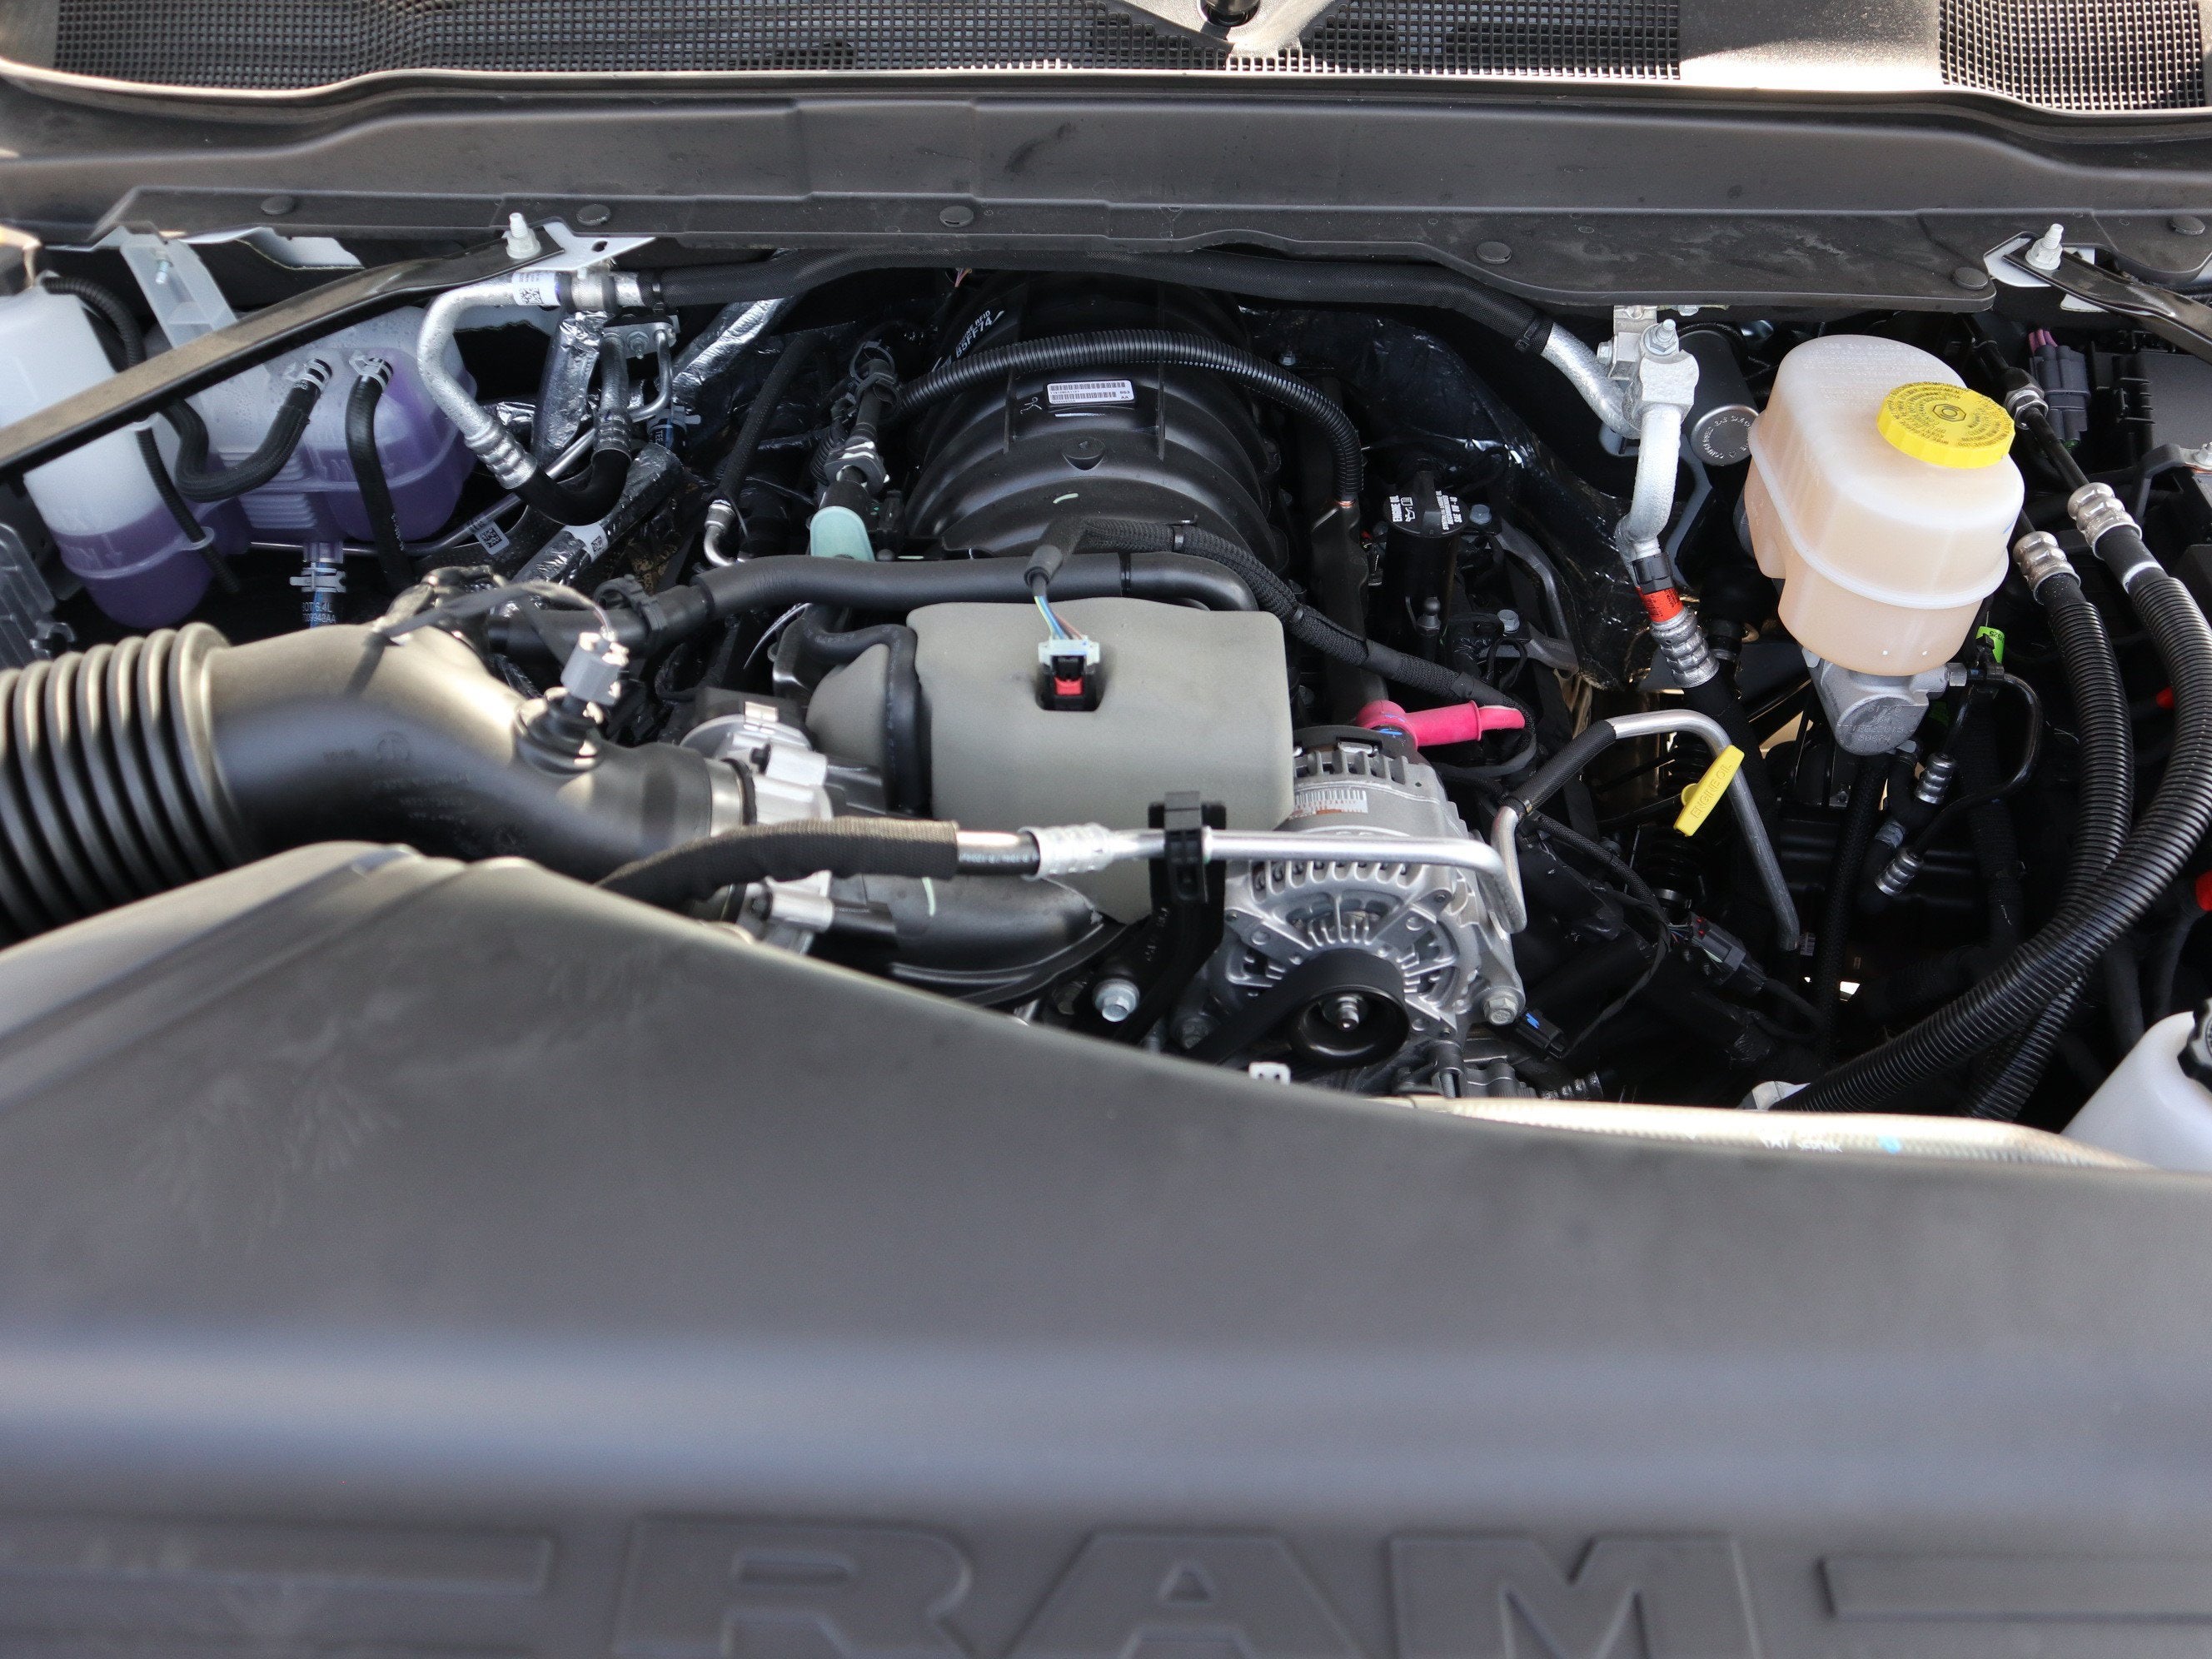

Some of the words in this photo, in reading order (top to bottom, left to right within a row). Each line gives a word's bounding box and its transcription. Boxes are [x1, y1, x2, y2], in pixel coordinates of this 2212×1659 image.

[1690, 780, 1718, 820] ENGINE
[1716, 764, 1732, 780] OIL
[612, 1518, 1759, 1659] RAM
